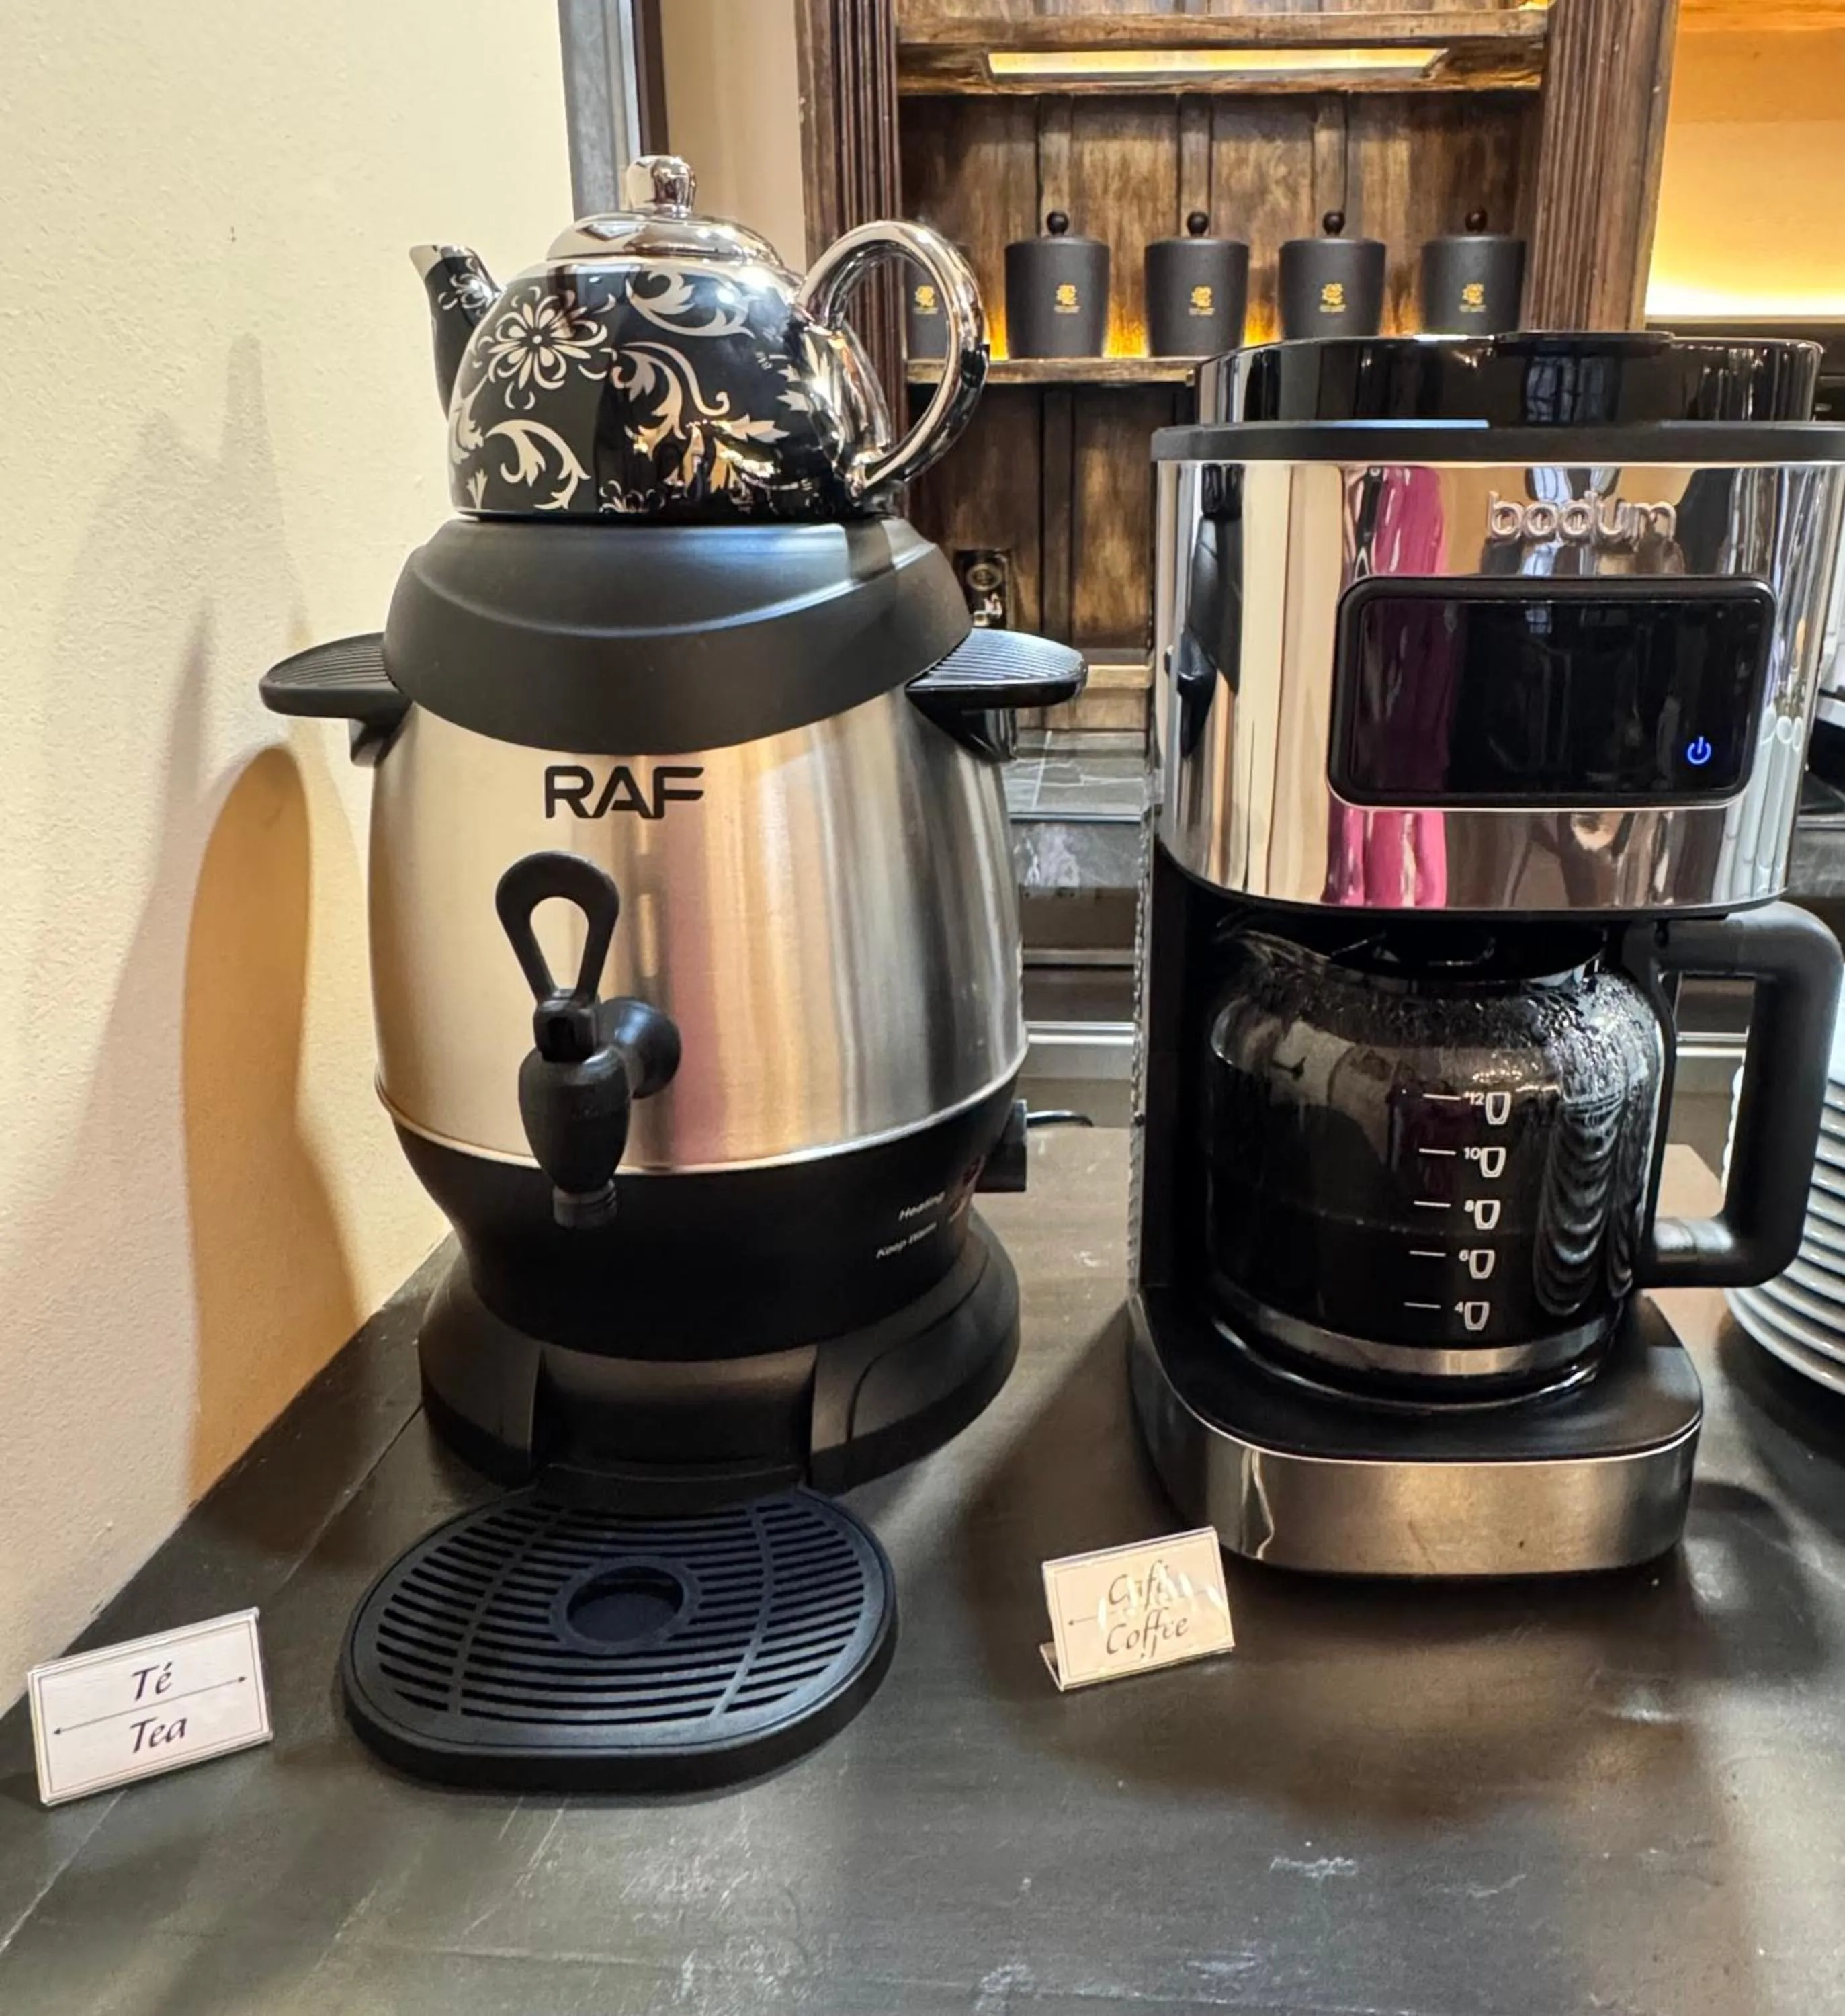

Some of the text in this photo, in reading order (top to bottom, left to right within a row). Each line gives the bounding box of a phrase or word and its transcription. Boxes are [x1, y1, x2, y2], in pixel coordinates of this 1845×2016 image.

[1488, 490, 1677, 540] bodum
[545, 765, 704, 819] RAF
[1468, 1091, 1484, 1106] 12
[1463, 1147, 1481, 1160] 10
[1464, 1200, 1475, 1212] 8
[1459, 1249, 1469, 1261] 6
[1454, 1302, 1463, 1313] 4
[1107, 1605, 1190, 1660] Coffee
[132, 1661, 173, 1702] Té
[130, 1717, 187, 1754] Tea
